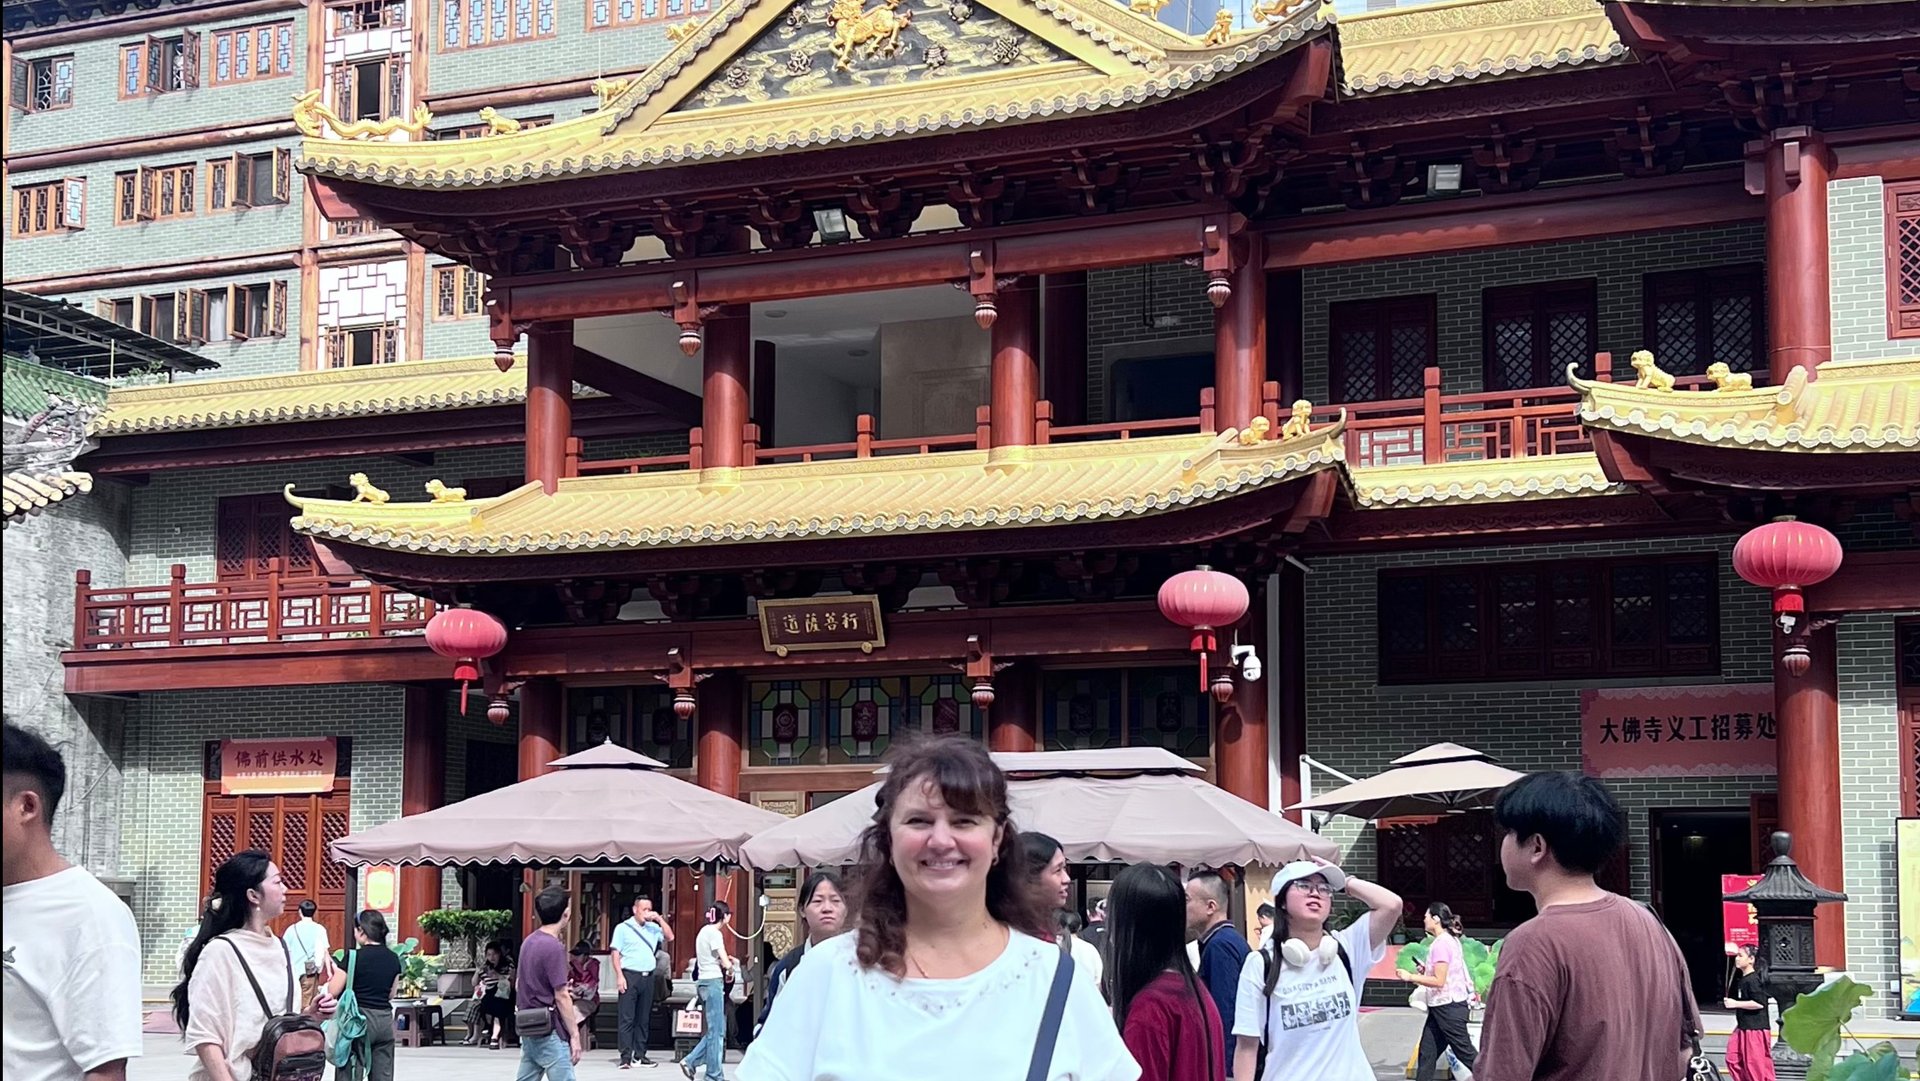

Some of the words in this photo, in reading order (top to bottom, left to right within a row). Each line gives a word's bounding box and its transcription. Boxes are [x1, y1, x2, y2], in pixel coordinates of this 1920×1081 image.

[1600, 712, 1776, 744] 大佛寺义工招募处
[235, 749, 324, 769] 佛前供水处
